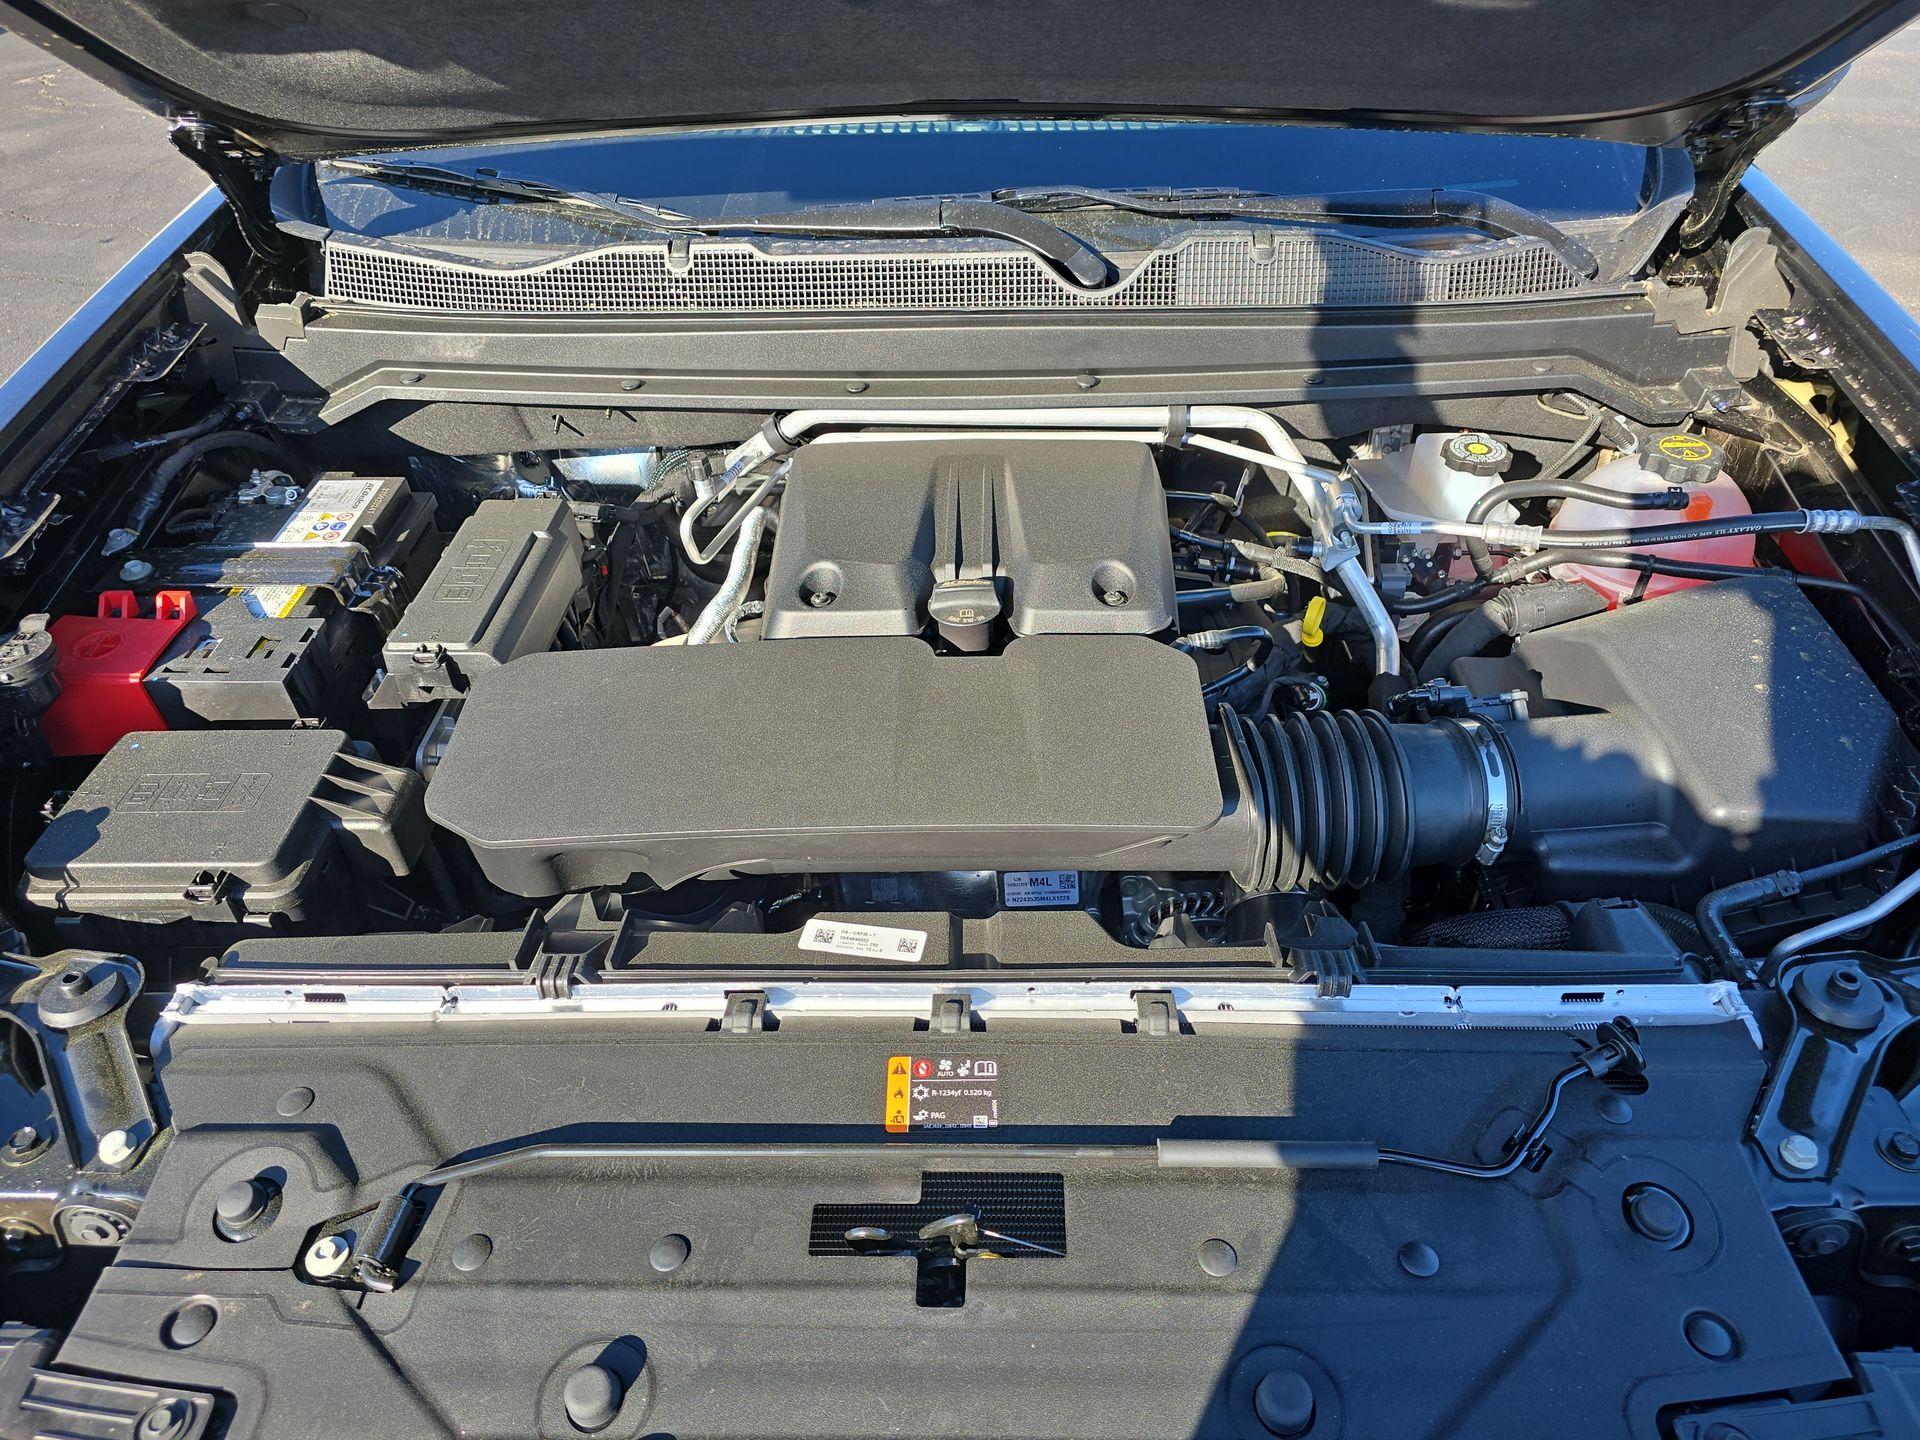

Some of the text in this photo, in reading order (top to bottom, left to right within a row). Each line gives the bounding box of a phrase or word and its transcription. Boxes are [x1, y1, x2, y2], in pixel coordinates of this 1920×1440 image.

[352, 483, 374, 509] ACDelco
[1728, 525, 1762, 534] GALAXY
[1029, 877, 1053, 887] M4L
[931, 1089, 962, 1097] R-1234yf
[983, 1089, 992, 1097] kg
